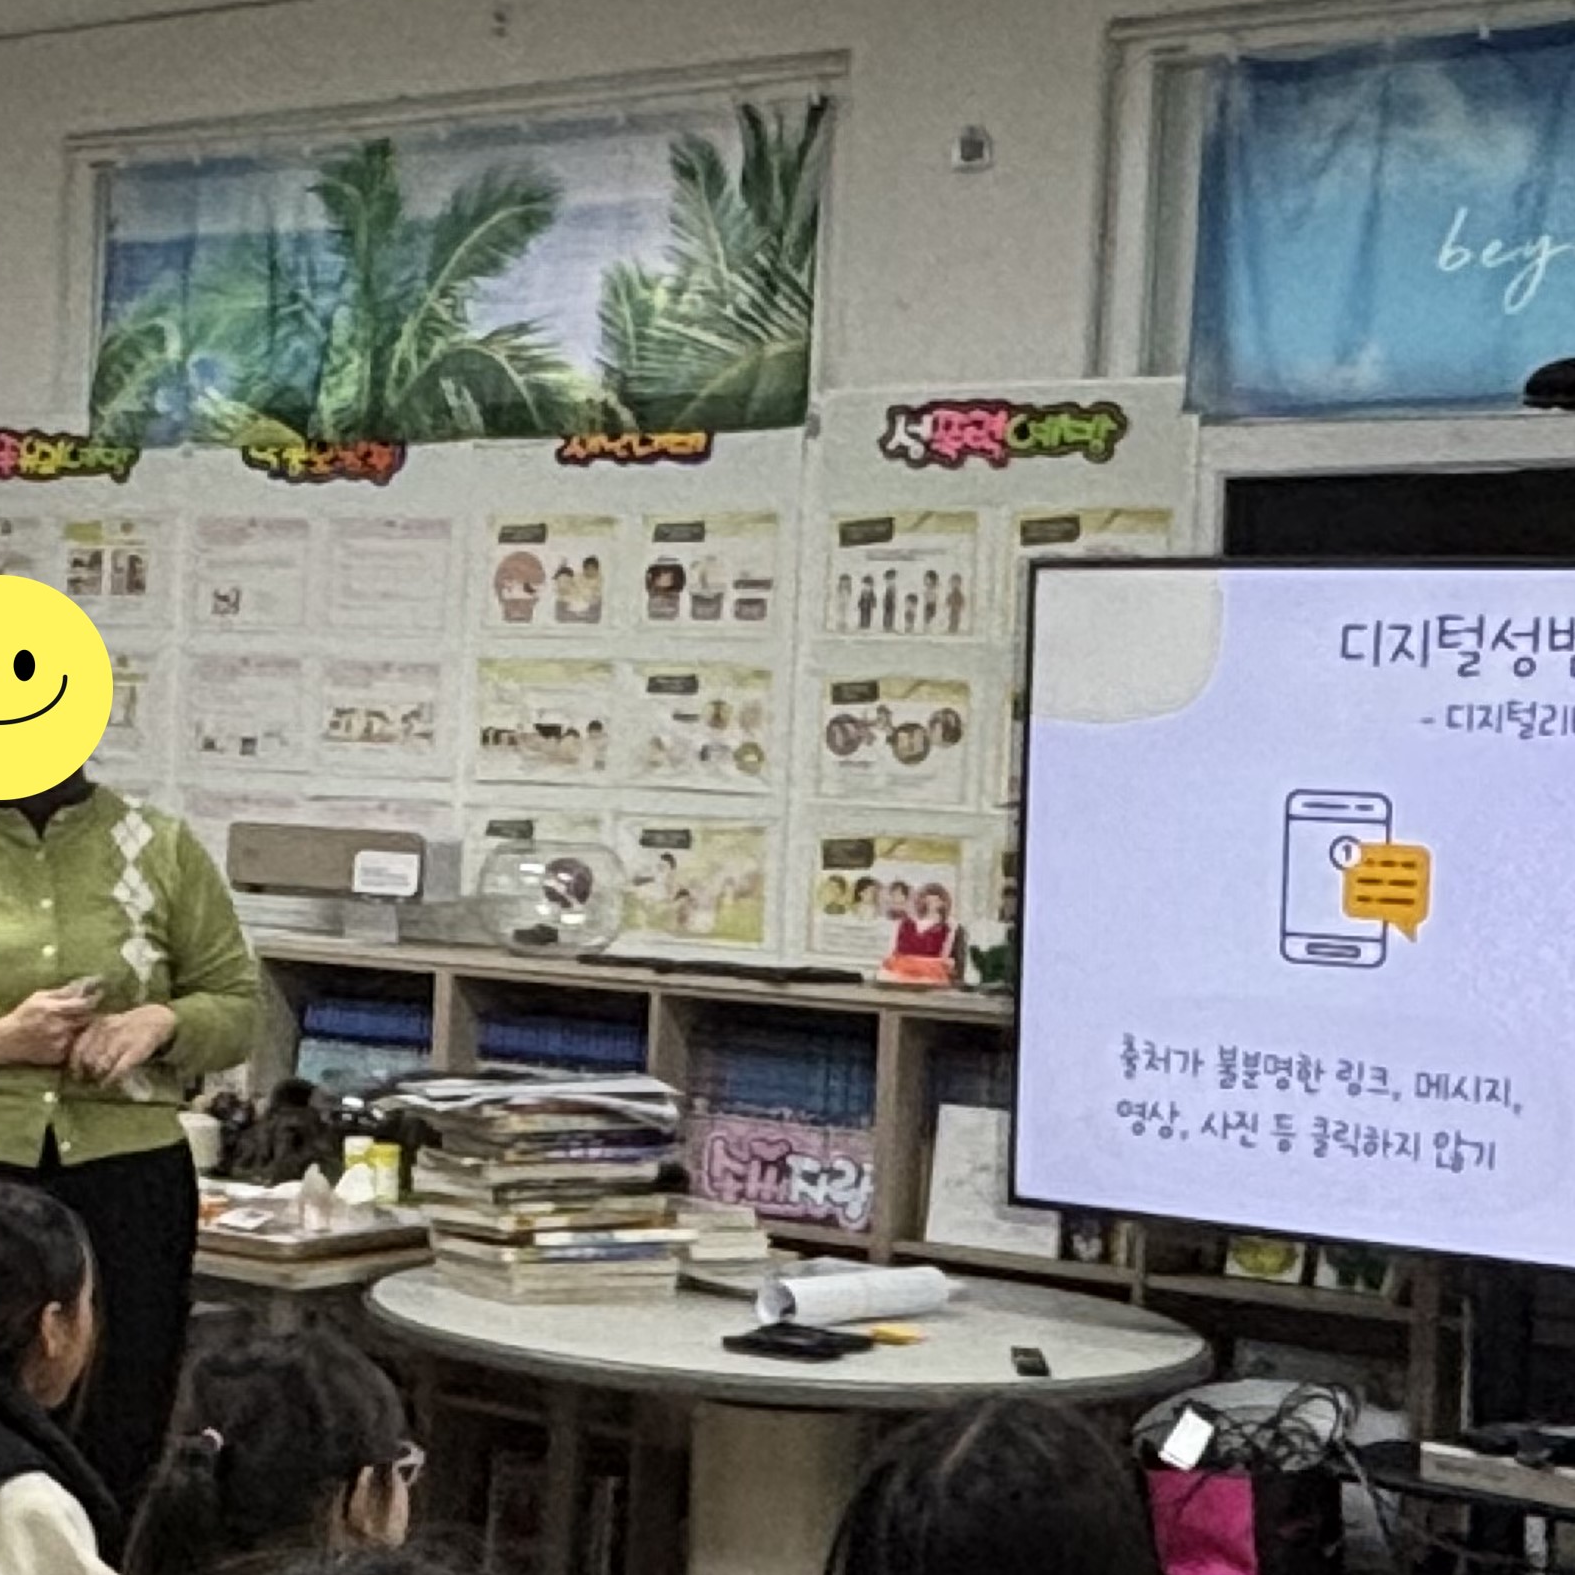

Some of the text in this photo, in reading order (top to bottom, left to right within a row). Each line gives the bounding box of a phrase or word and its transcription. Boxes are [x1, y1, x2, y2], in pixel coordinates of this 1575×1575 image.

[1121, 1032, 1524, 1116] 출처가 불분명한 링크, 메시지,
[1116, 1098, 1498, 1174] 영상, 사진 등 클릭하지 않기
